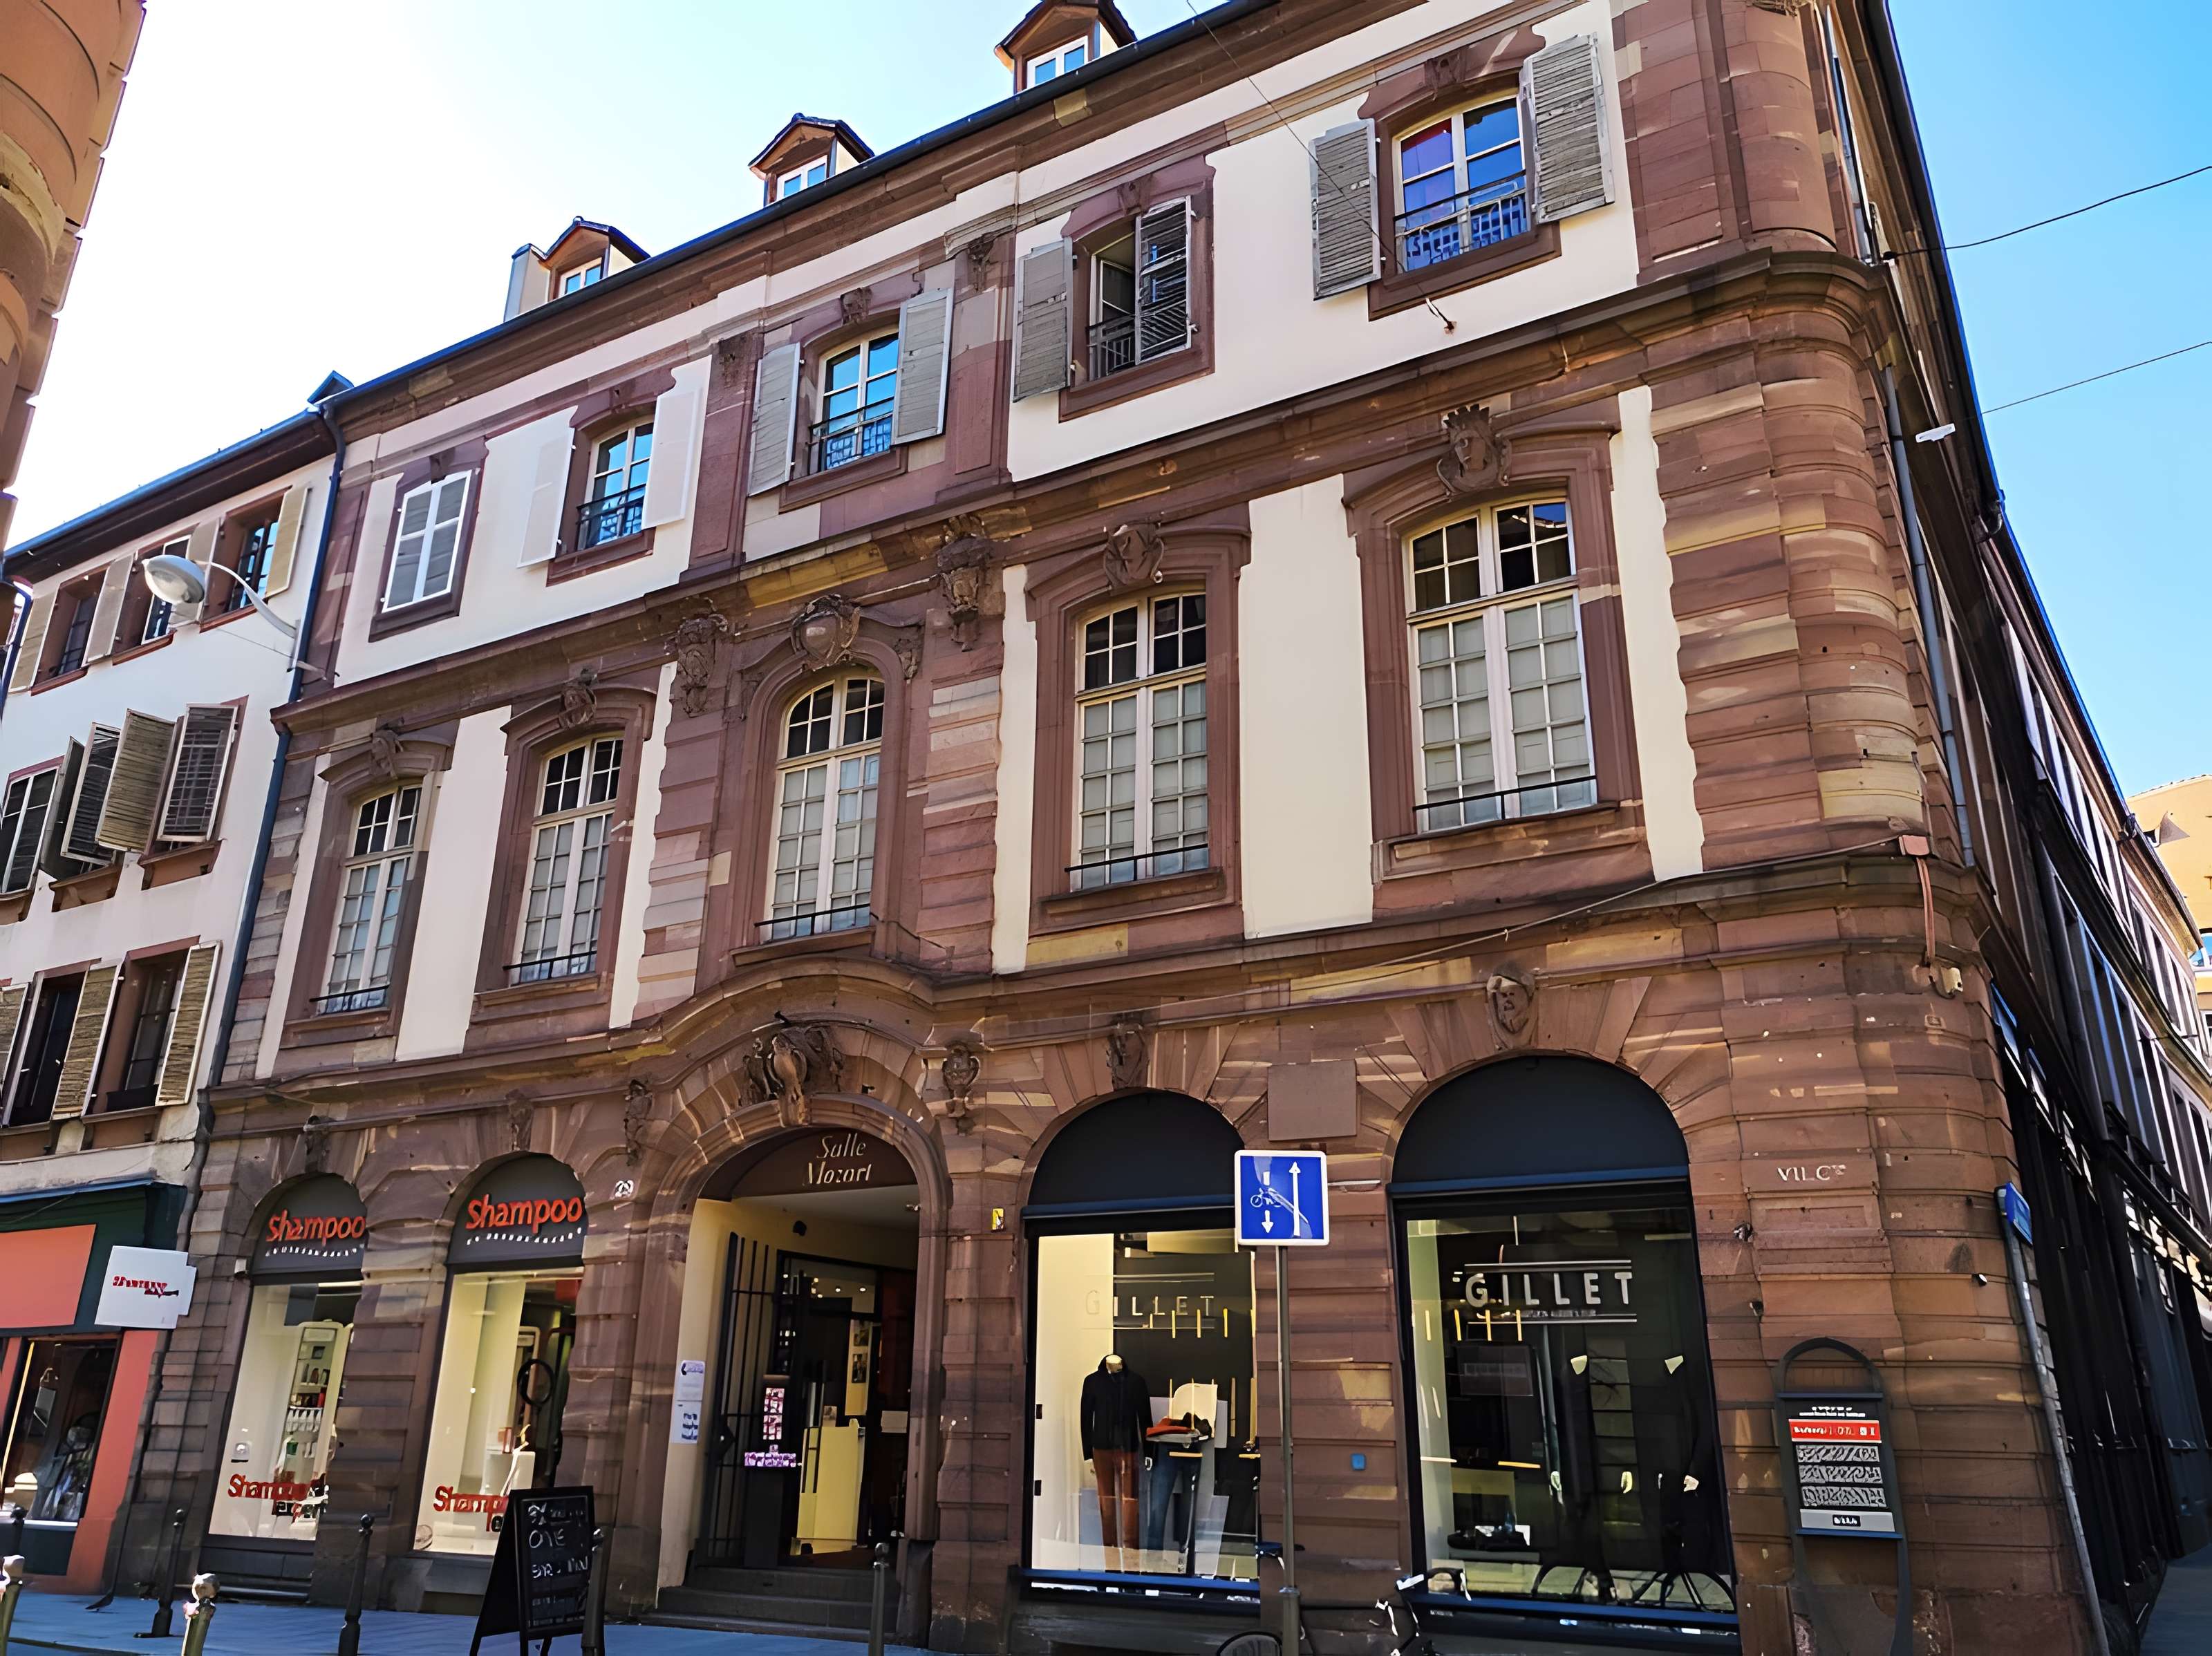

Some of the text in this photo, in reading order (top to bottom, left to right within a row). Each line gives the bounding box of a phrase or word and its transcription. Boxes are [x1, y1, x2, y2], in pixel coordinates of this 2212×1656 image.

[816, 1133, 866, 1158] Salle
[265, 1209, 366, 1247] Shampoo
[465, 1194, 583, 1234] Shampoo
[1085, 1290, 1215, 1317] GILLET
[1465, 1272, 1633, 1308] GILLET
